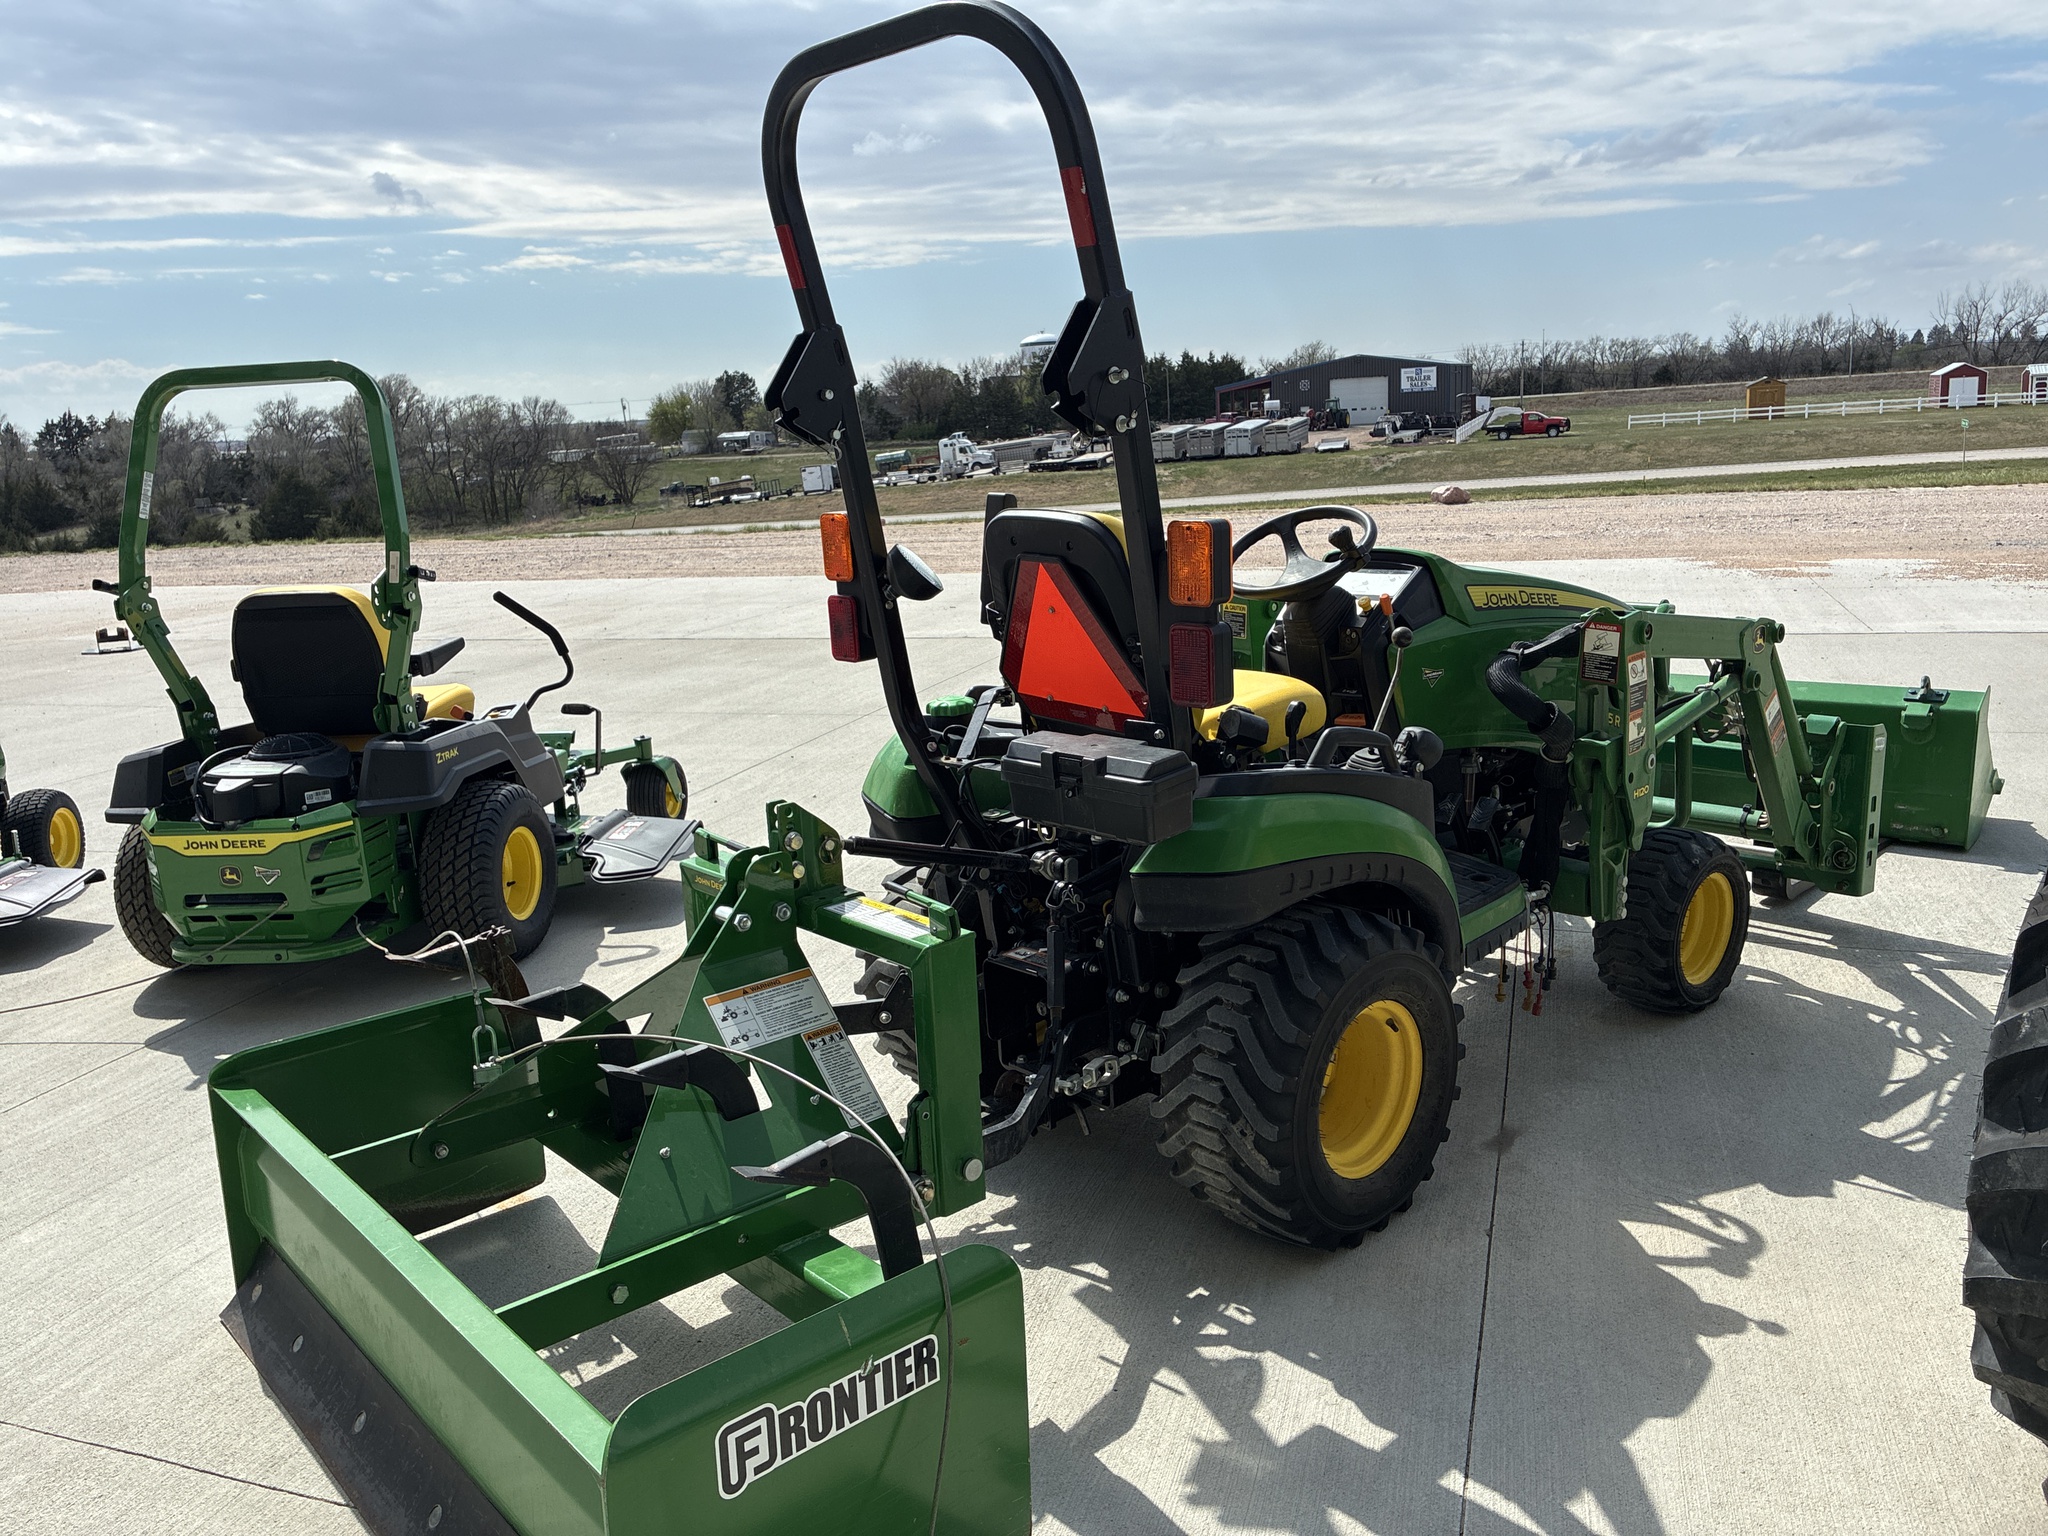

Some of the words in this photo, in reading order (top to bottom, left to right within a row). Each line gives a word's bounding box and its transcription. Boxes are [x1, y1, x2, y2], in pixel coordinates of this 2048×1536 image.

[1482, 591, 1518, 607] JOHN
[1519, 590, 1559, 606] DEERE
[1595, 623, 1618, 631] DANGER
[435, 746, 460, 765] ZTRAK
[1633, 785, 1650, 800] H120
[183, 840, 218, 850] JOHN
[220, 839, 267, 849] DEERE
[694, 875, 711, 887] JOHN
[749, 979, 782, 992] WARNING
[811, 1025, 840, 1039] WARNING
[717, 1336, 939, 1497] FRONTIER
